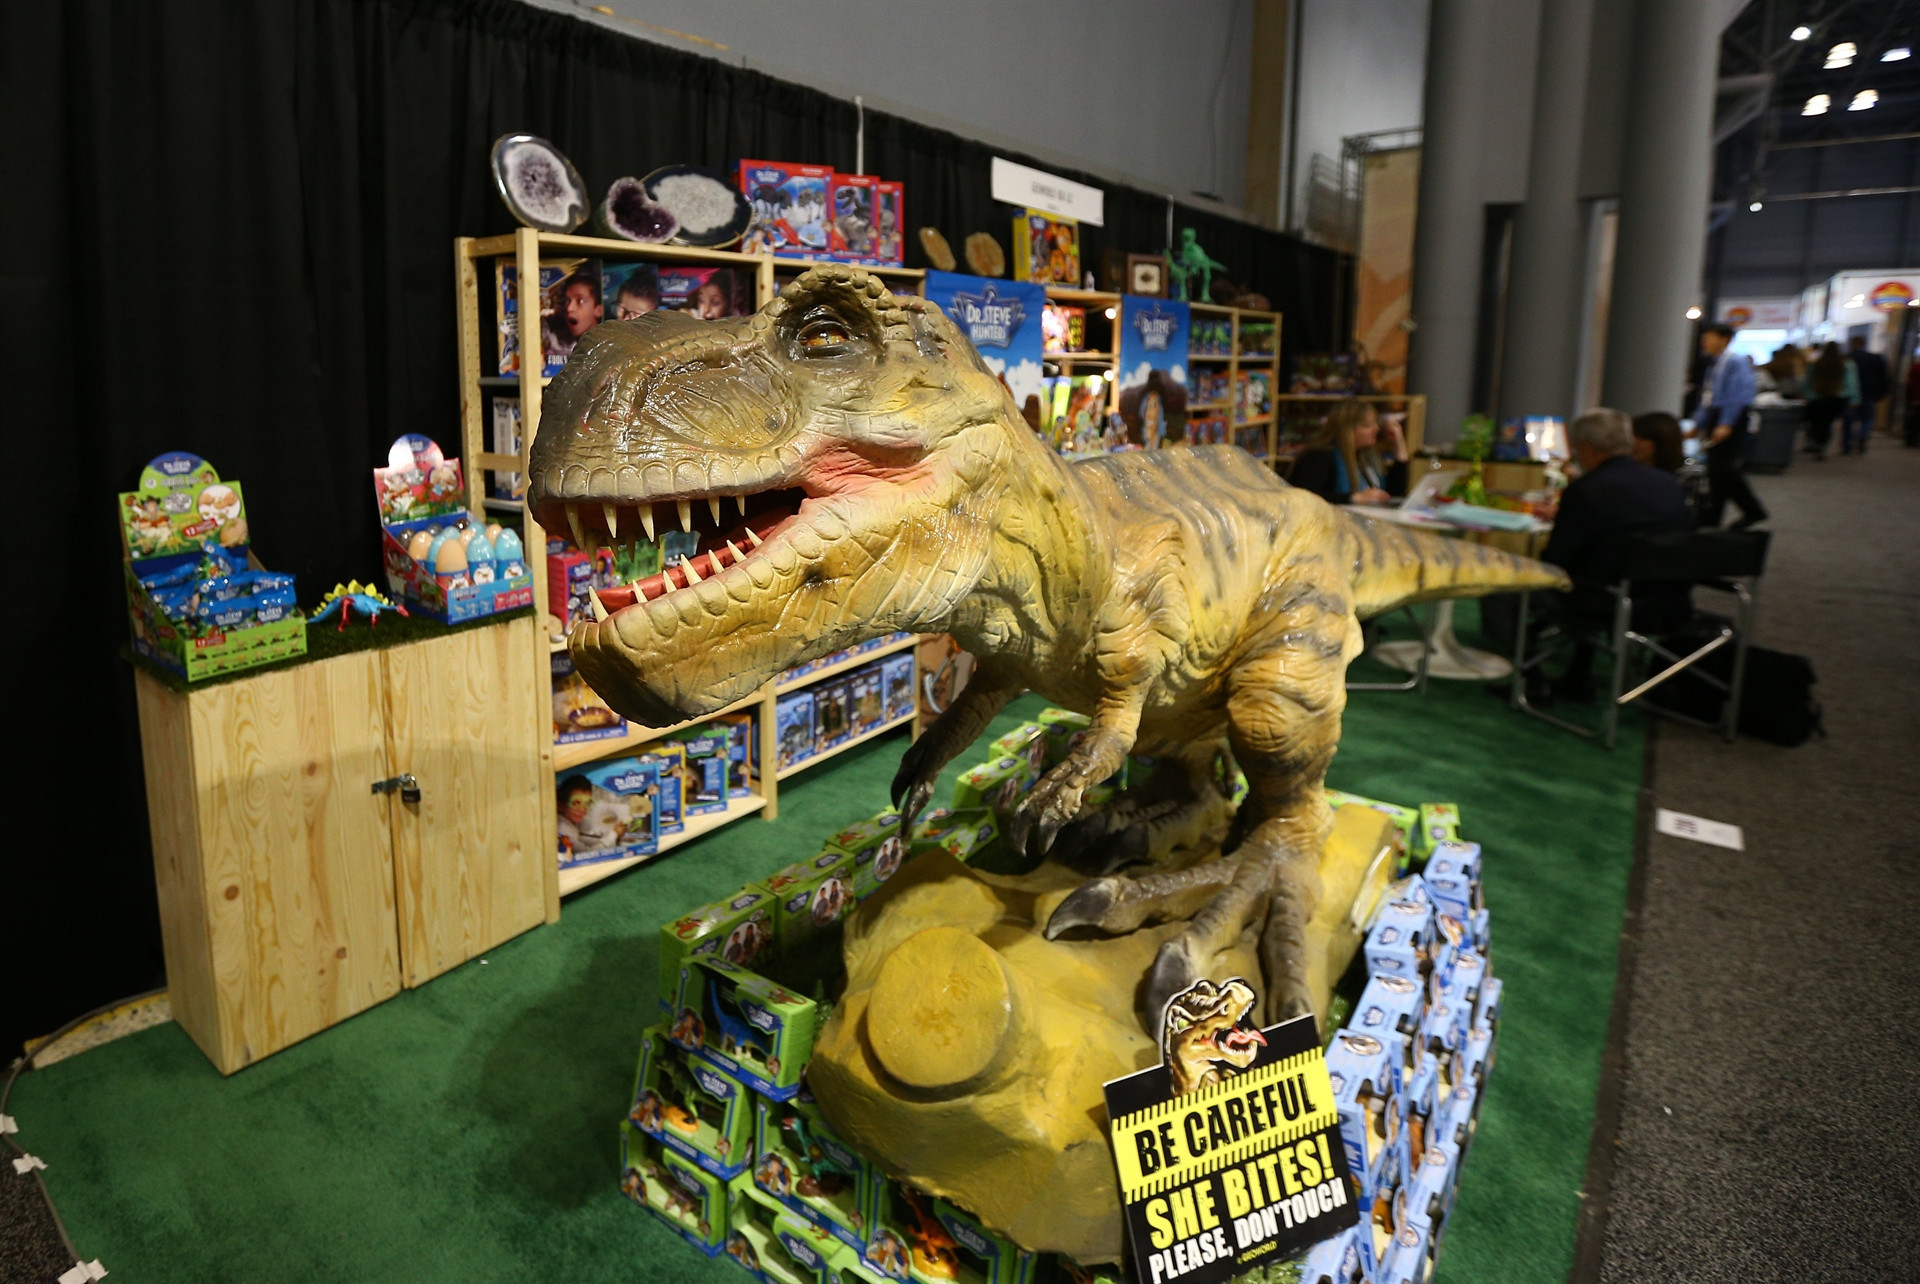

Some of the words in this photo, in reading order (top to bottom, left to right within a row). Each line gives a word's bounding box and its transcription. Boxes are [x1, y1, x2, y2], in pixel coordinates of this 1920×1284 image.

[1134, 1121, 1180, 1177] BE
[1184, 1074, 1316, 1157] CAREFUL
[1145, 1179, 1219, 1250] SHE
[1222, 1134, 1335, 1219] BITES!
[1148, 1227, 1234, 1284] PLEASE,
